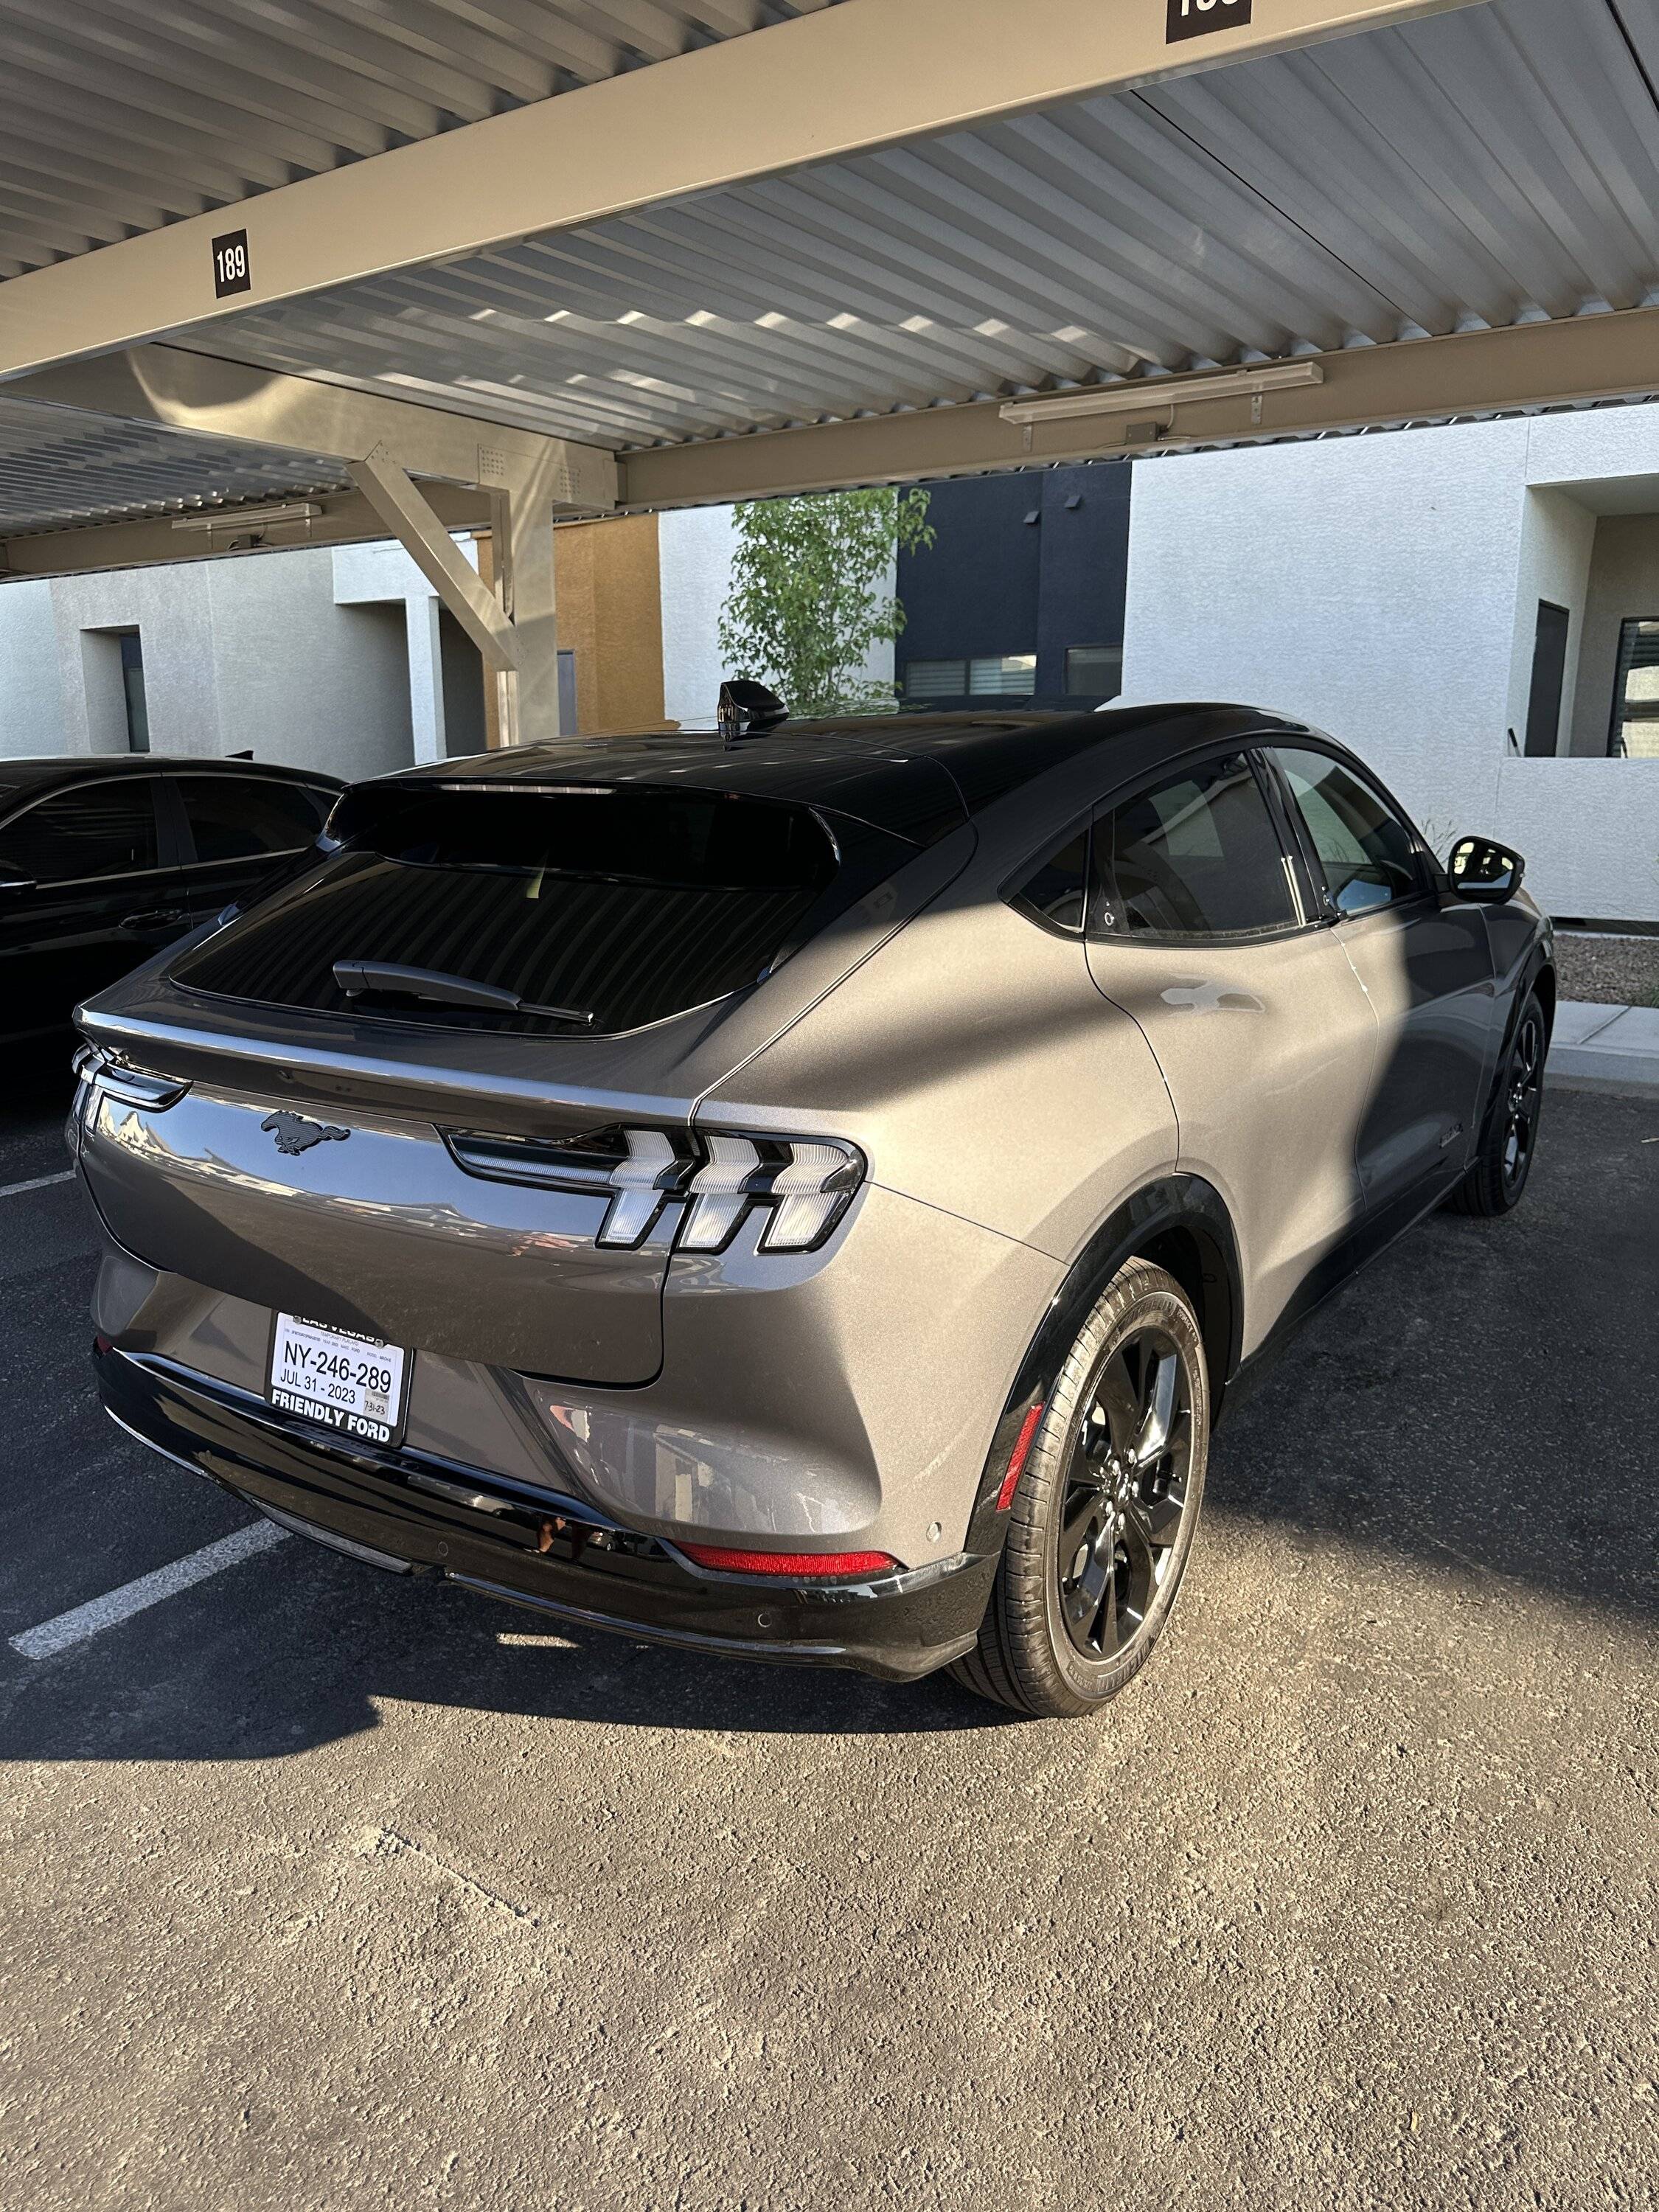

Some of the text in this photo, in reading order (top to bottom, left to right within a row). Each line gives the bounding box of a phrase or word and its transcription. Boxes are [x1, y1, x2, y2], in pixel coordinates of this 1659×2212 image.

[217, 245, 246, 282] 189
[280, 1368, 301, 1388] JUL
[305, 1375, 317, 1392] 31
[327, 1383, 355, 1404] 2023
[284, 1340, 392, 1394] NY-246-289
[272, 1388, 390, 1442] FRIENDLY FORD
